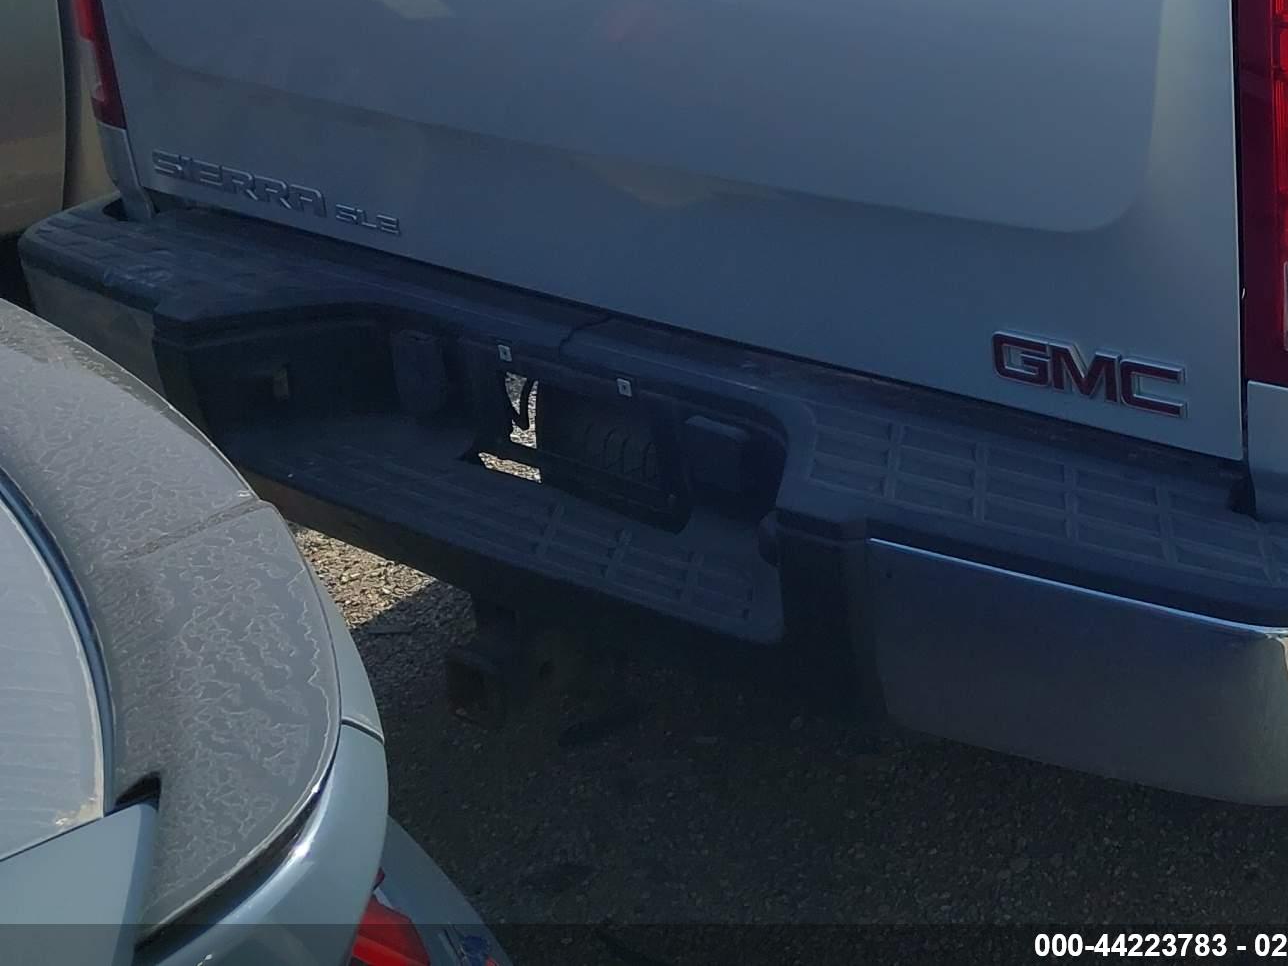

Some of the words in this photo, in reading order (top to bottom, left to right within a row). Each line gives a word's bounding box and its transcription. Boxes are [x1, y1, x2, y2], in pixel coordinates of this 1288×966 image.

[152, 149, 327, 218] SIERRA
[335, 203, 401, 235] SLE
[992, 330, 1188, 418] GMC
